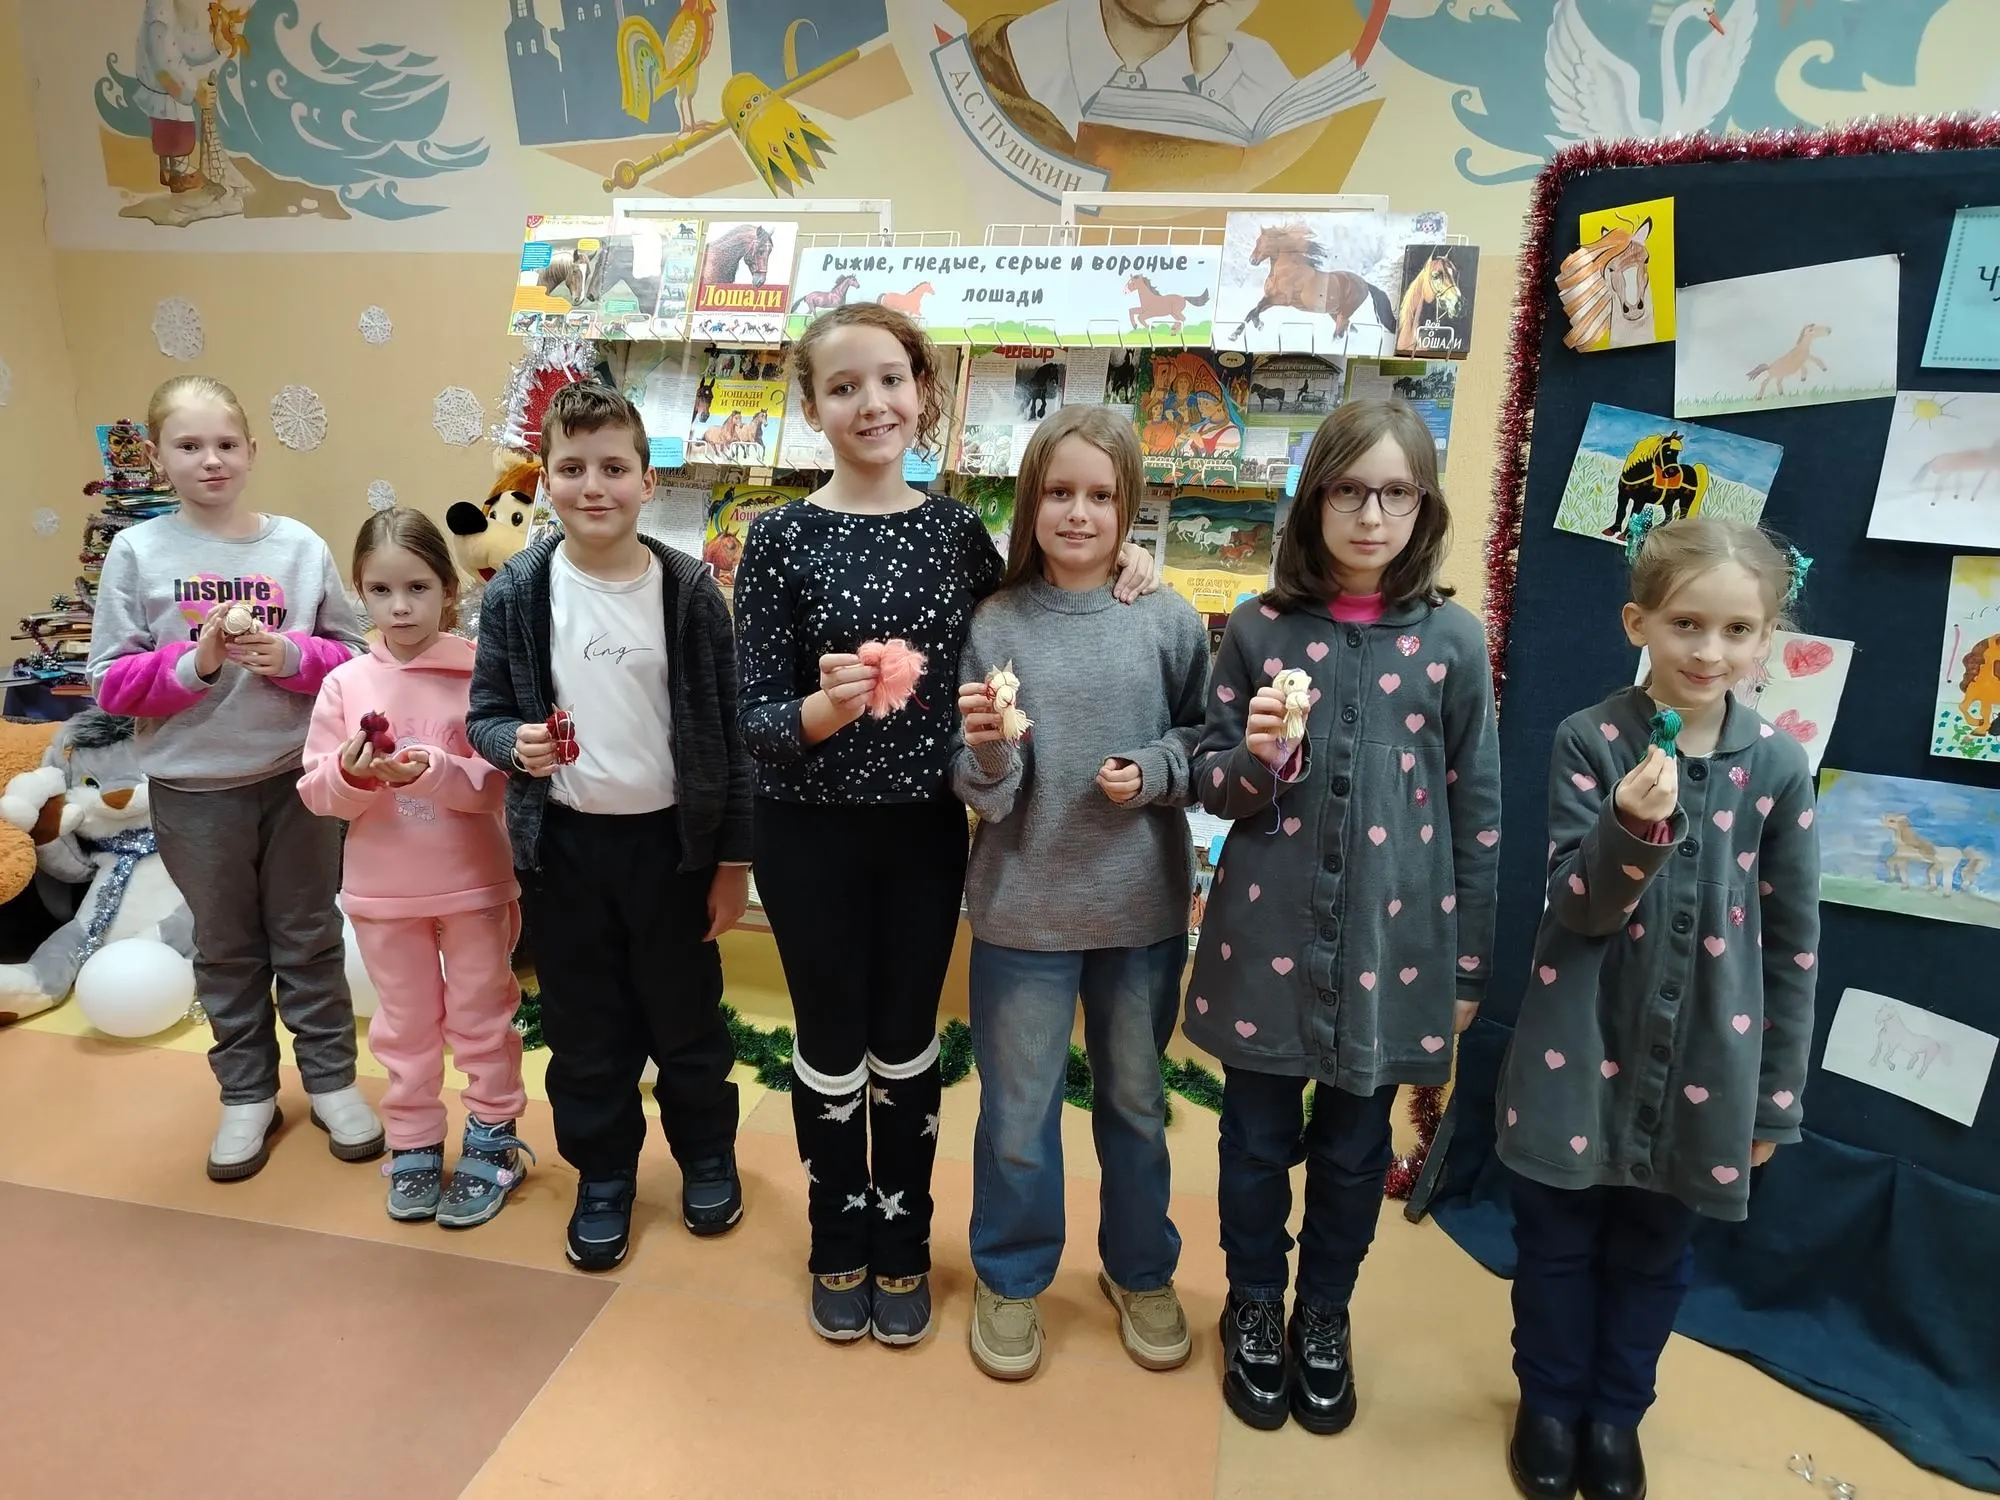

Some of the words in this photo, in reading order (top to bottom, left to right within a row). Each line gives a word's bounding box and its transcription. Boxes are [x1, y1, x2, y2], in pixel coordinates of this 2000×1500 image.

[978, 112, 1082, 191] ПУШКИН
[822, 253, 894, 273] Рыжие,
[902, 255, 986, 274] гнедые,
[995, 255, 1062, 275] серые
[1070, 255, 1083, 271] и
[1091, 255, 1188, 276] вороные
[699, 284, 784, 311] Лошади
[962, 287, 1044, 307] лошади
[720, 390, 764, 399] ЛОШАДИ
[731, 399, 760, 407] ПОНИ
[174, 578, 271, 602] Inspire
[583, 632, 654, 664] King
